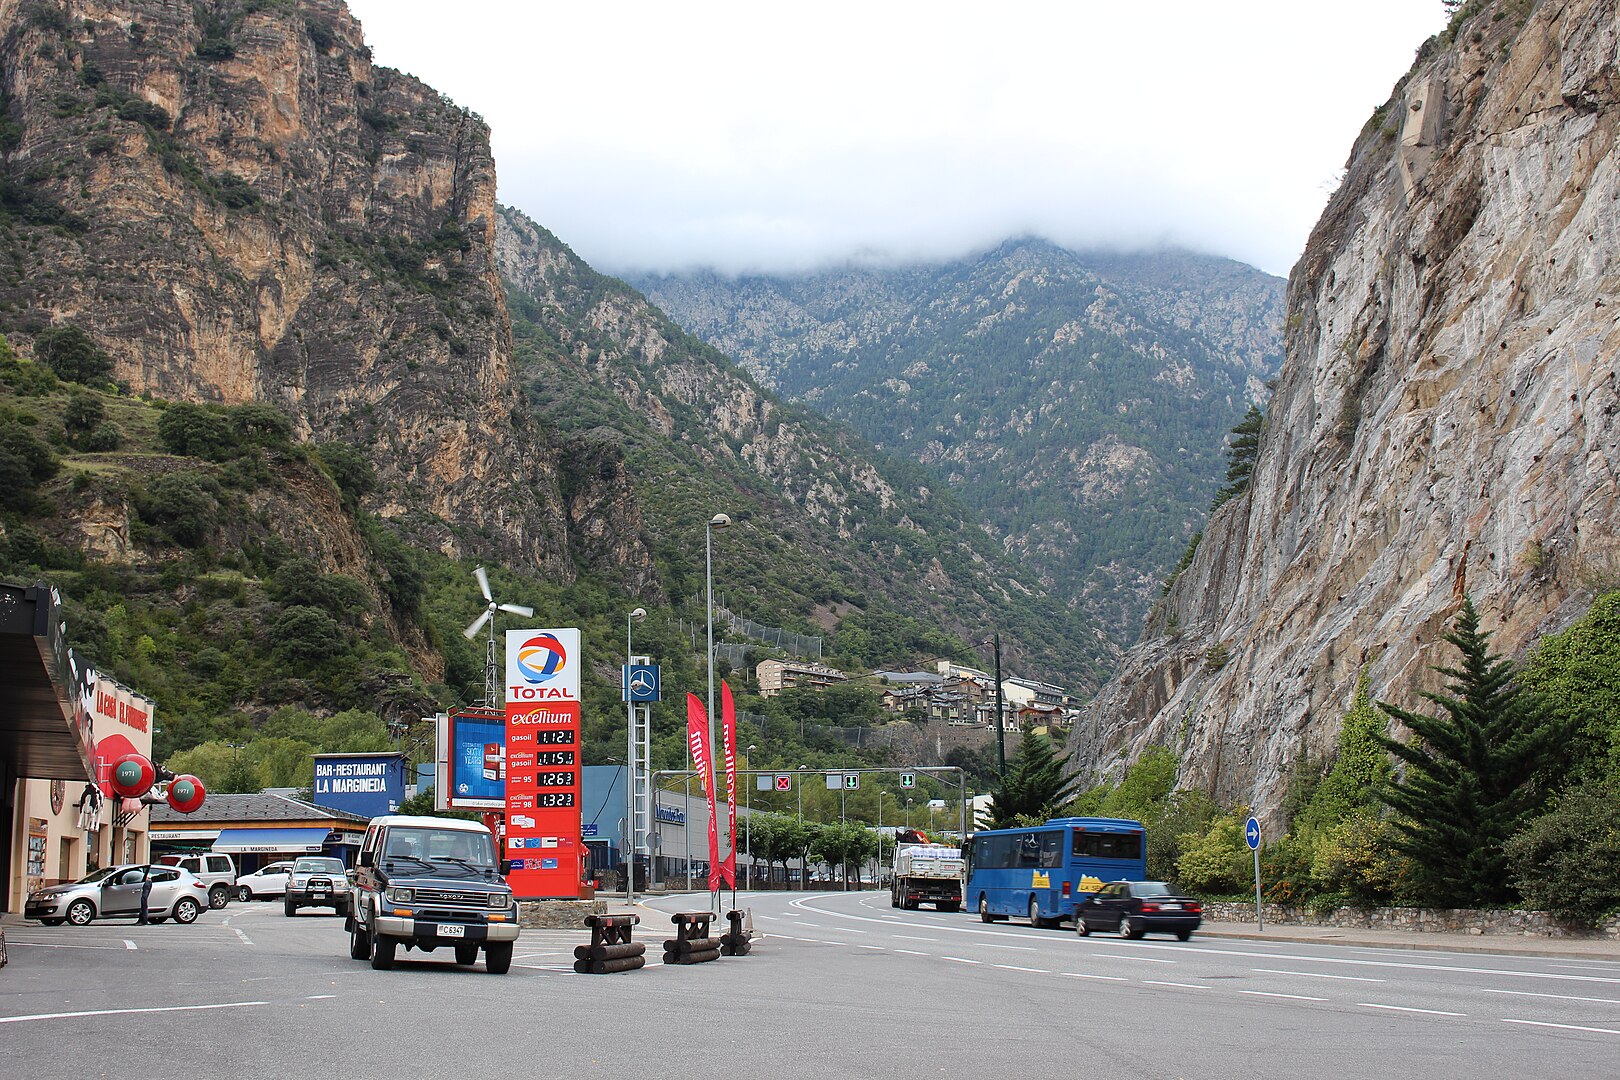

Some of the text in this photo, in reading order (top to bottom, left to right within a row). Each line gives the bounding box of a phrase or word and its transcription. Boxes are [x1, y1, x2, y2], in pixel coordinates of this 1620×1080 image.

[509, 685, 574, 700] TOTAL
[97, 690, 103, 714] LA
[511, 710, 572, 725] excellium
[511, 734, 532, 742] gasoil
[464, 756, 482, 765] YEARS
[511, 760, 532, 768] gasoil
[316, 763, 387, 777] BAR-RESTAURANT
[316, 778, 386, 793] LA MARGINEDA
